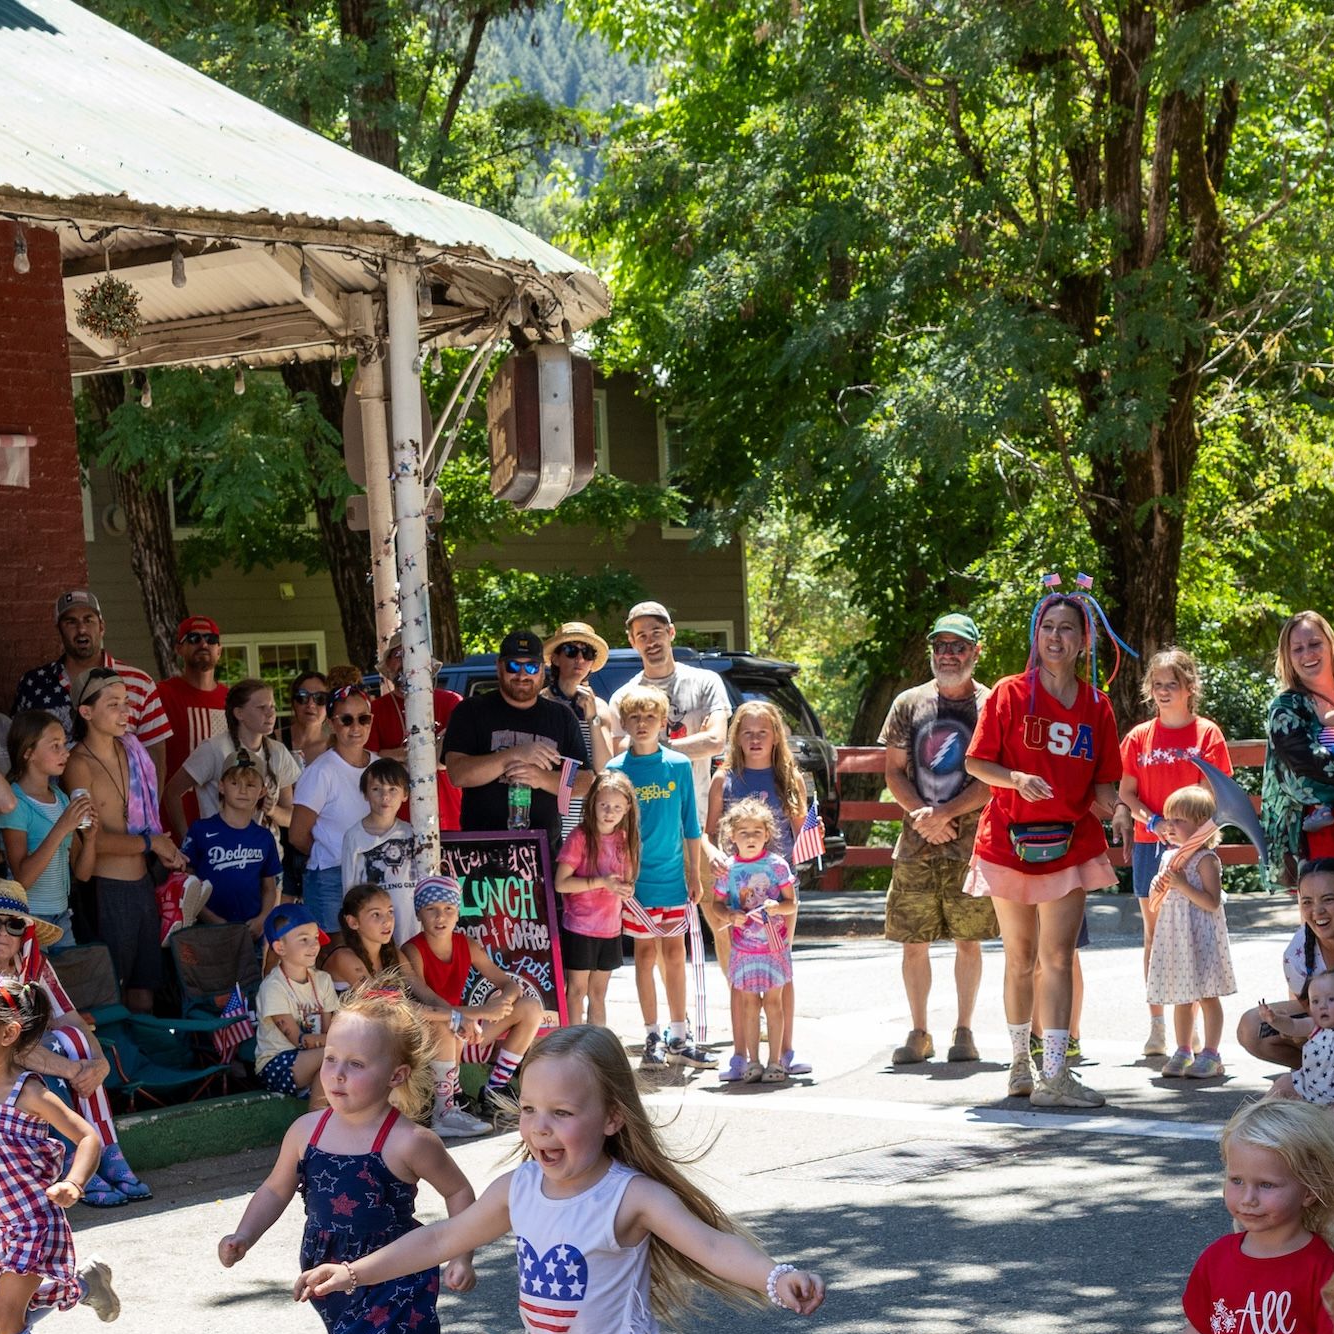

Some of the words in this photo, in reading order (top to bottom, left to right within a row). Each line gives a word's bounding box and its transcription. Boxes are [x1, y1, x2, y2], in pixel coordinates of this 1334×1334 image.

[1023, 714, 1094, 761] USA
[635, 782, 660, 795] each
[639, 788, 670, 803] sports
[208, 844, 263, 870] Dodgers
[458, 876, 537, 919] LUNCH
[503, 917, 551, 951] Coffee
[512, 956, 554, 992] patio
